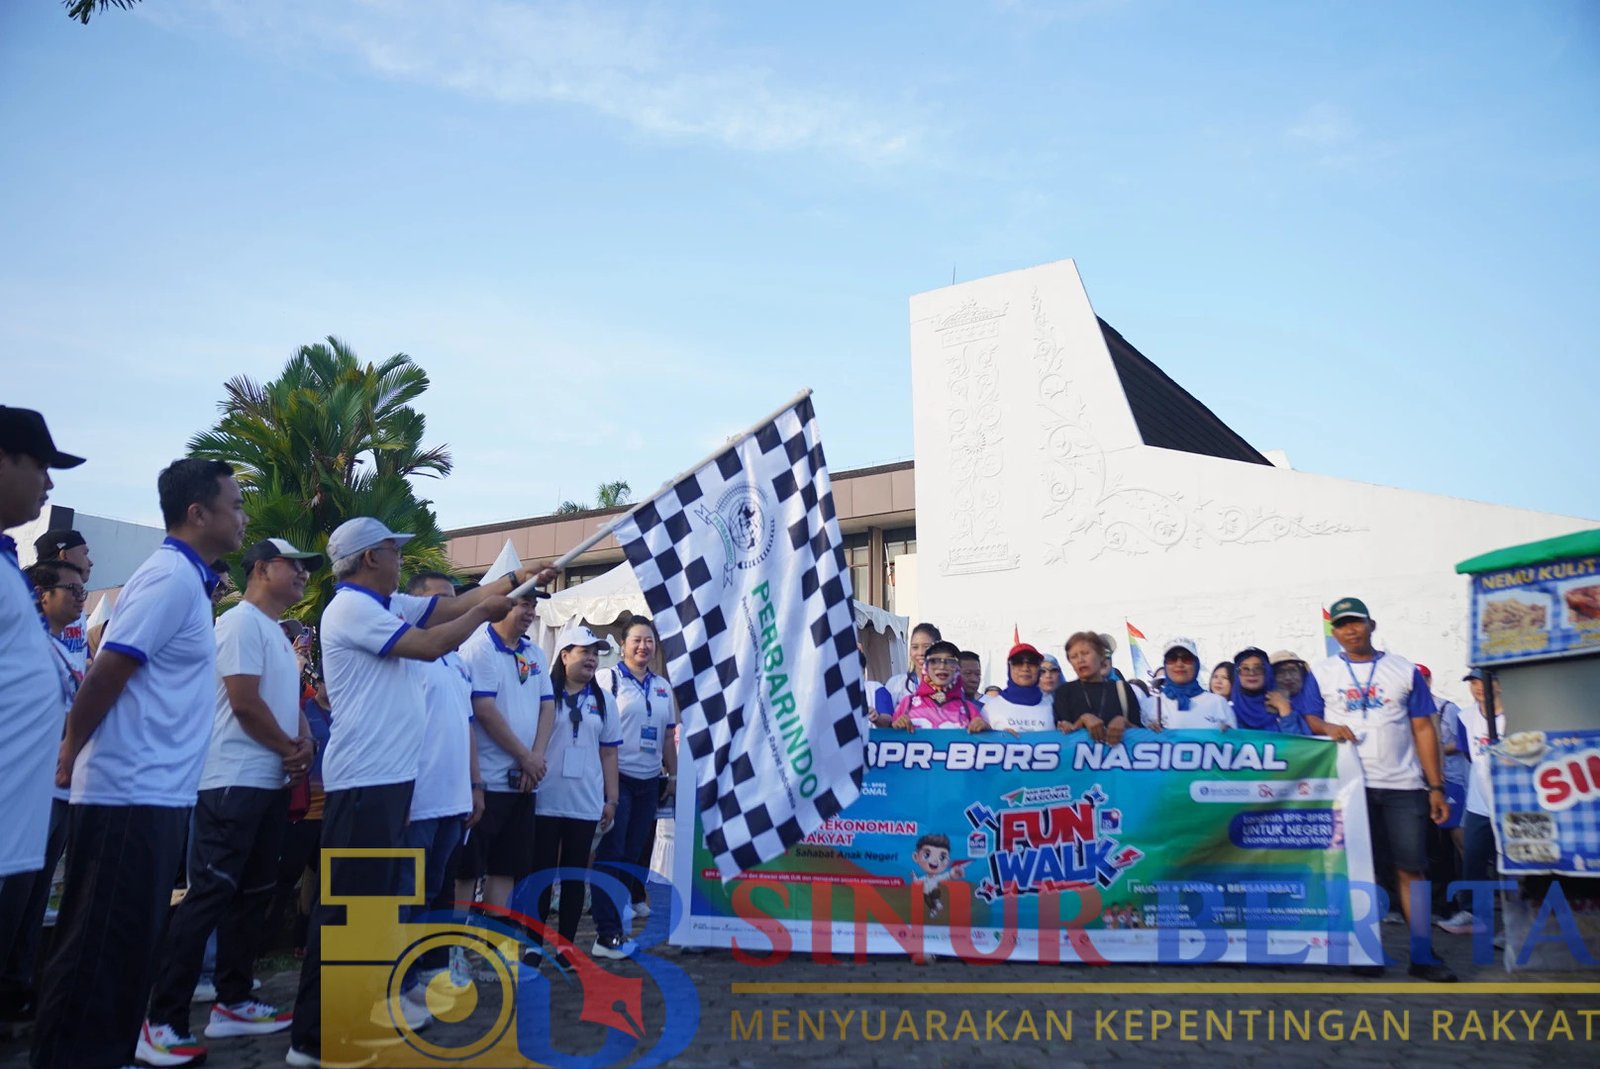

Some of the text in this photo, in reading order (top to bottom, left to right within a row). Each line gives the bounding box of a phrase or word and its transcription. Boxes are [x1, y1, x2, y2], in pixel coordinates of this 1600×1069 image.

[1538, 559, 1596, 581] KULIT
[751, 579, 819, 799] PERBARINDO
[1007, 717, 1046, 728] QUEEN
[1073, 741, 1288, 772] NASIONAL
[820, 818, 917, 836] EKONOMIAN
[1001, 802, 1095, 853] FUN
[1242, 824, 1333, 837] UNTUK NEGERI
[796, 847, 899, 862] Sahabat Anak Negeri
[996, 838, 1122, 890] WALK
